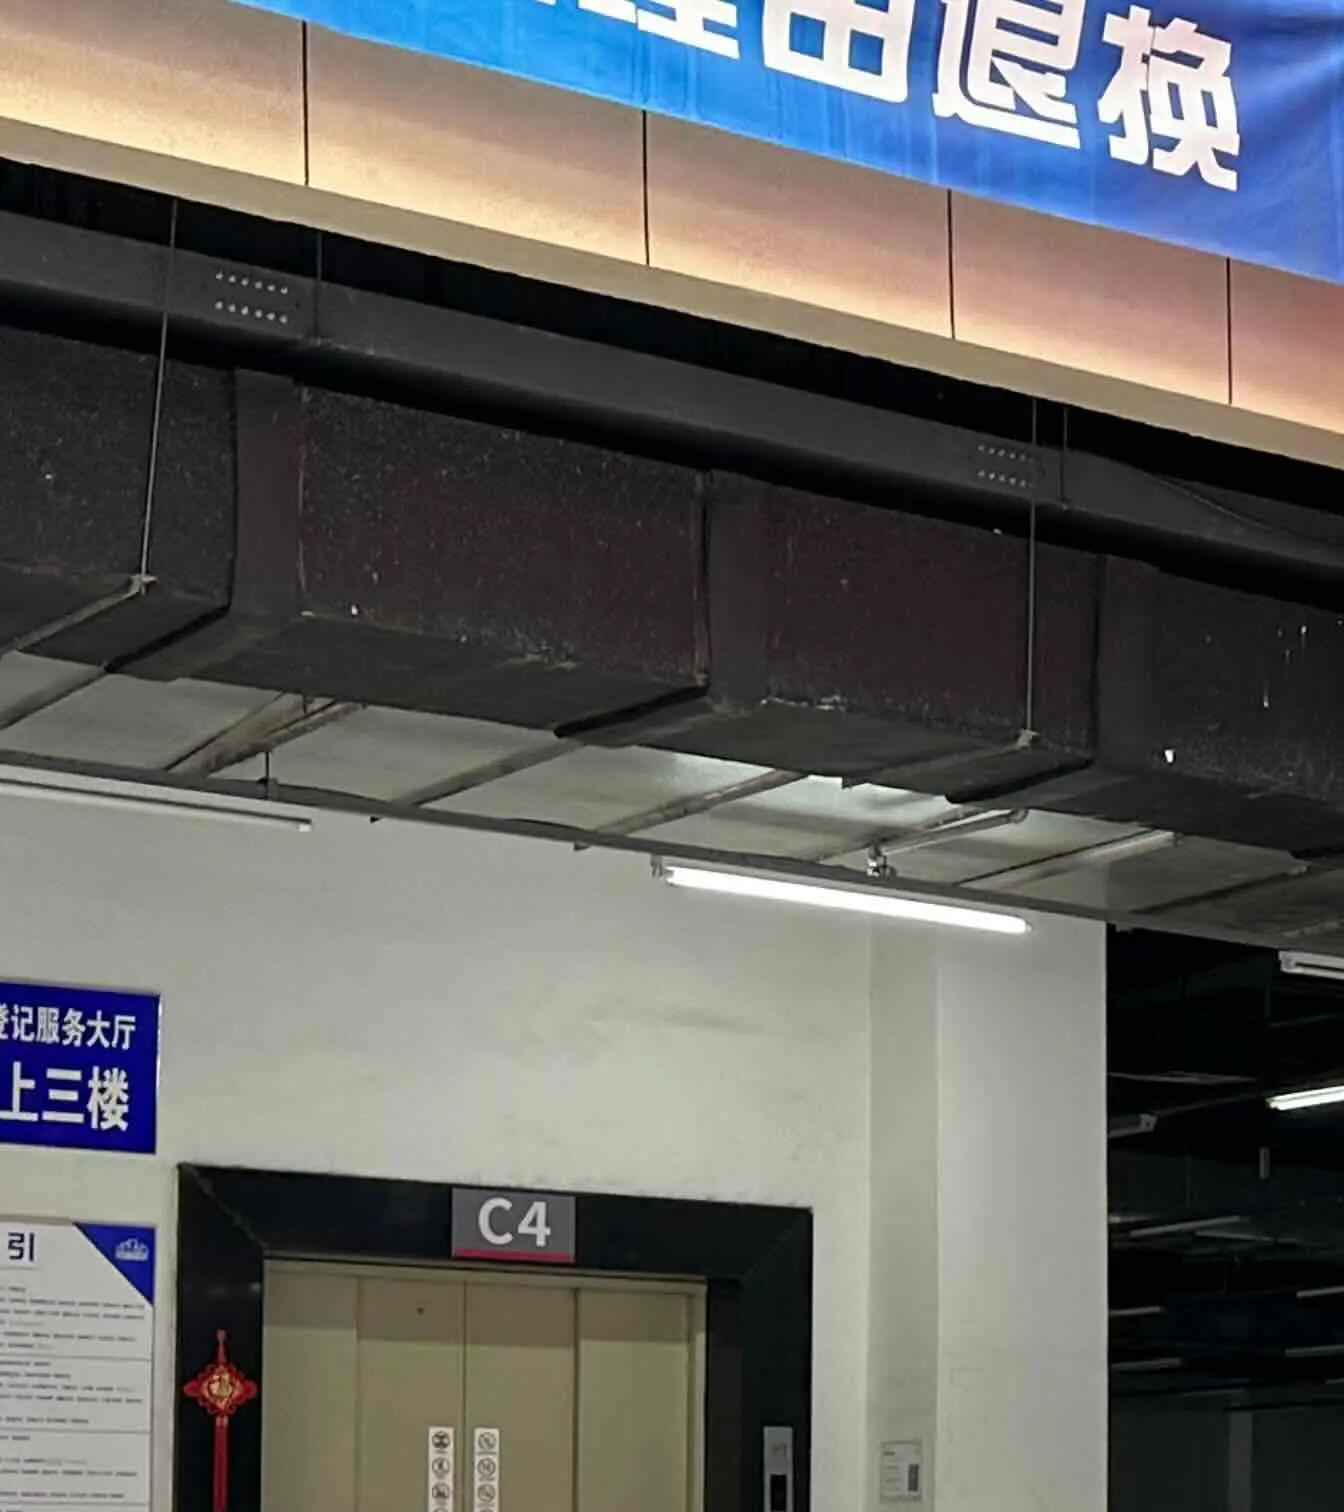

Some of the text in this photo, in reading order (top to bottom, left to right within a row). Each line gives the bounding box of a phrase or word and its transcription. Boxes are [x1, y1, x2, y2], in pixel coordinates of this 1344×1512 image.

[0, 1061, 129, 1131] 上三楼
[8, 1232, 35, 1262] 引
[478, 1197, 551, 1247] C4
